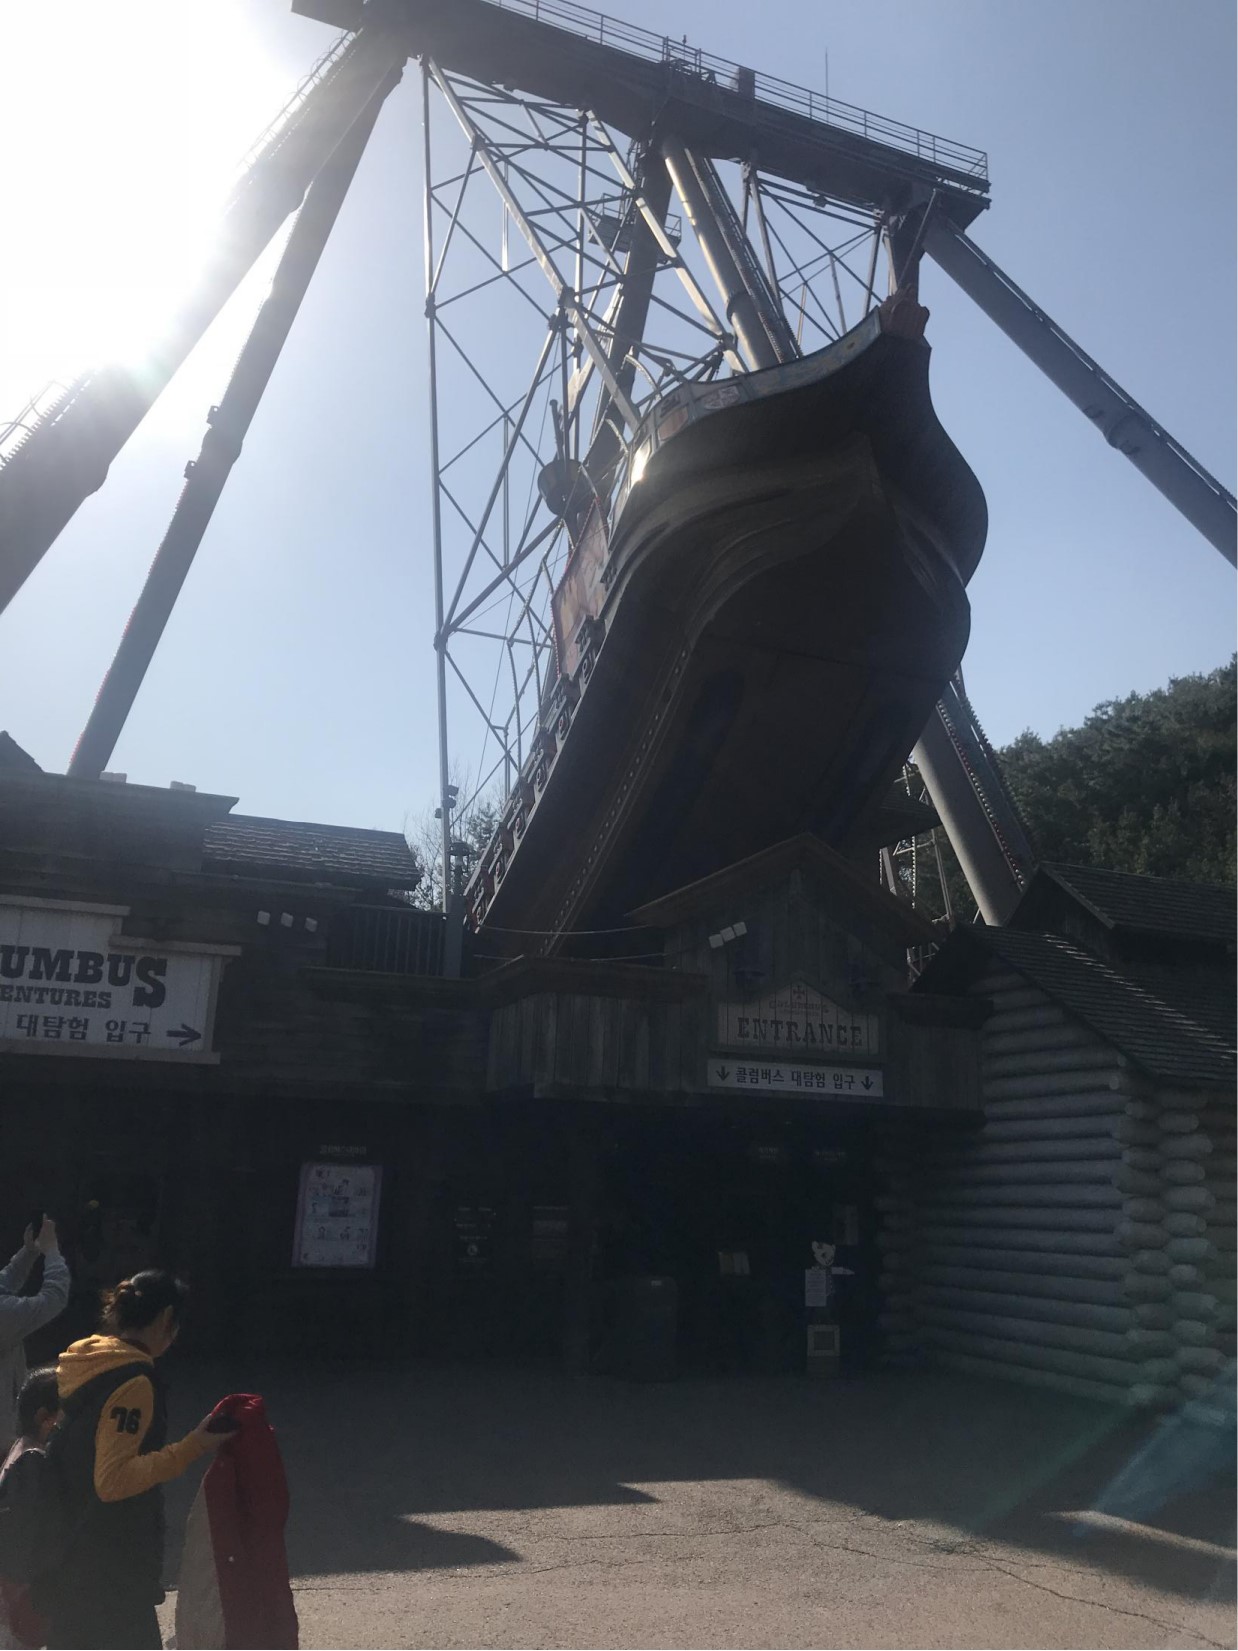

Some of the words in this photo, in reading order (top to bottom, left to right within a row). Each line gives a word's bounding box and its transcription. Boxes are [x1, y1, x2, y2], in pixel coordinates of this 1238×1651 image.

[0, 944, 168, 1008] UMBUS
[16, 1013, 90, 1041] 대탐험
[105, 1019, 152, 1044] 입구
[737, 1017, 863, 1047] ENTRANCE
[735, 1066, 785, 1085] 콜럼버스
[791, 1070, 826, 1088] 대탐험
[832, 1073, 856, 1090] 입구
[110, 1406, 142, 1435] 76
